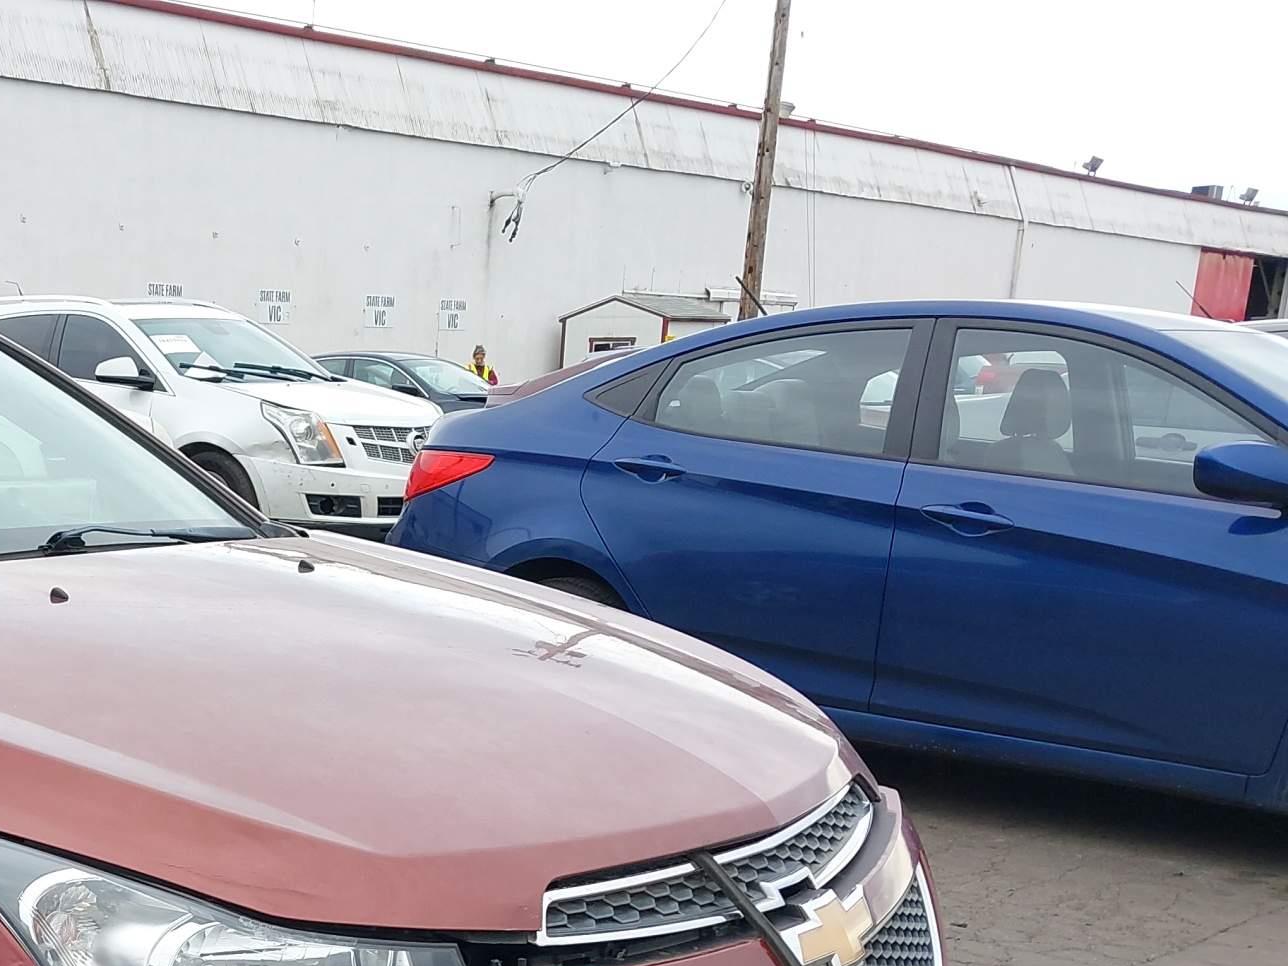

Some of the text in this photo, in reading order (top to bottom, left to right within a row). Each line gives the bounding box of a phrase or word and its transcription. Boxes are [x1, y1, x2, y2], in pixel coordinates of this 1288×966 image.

[148, 283, 183, 297] STATE FARM
[260, 290, 291, 303] STATE FARM
[366, 295, 395, 307] STATE FARM
[440, 299, 467, 311] STATE FARM
[268, 305, 282, 322] VIC
[374, 309, 387, 326] VIC
[447, 313, 459, 328] VIC
